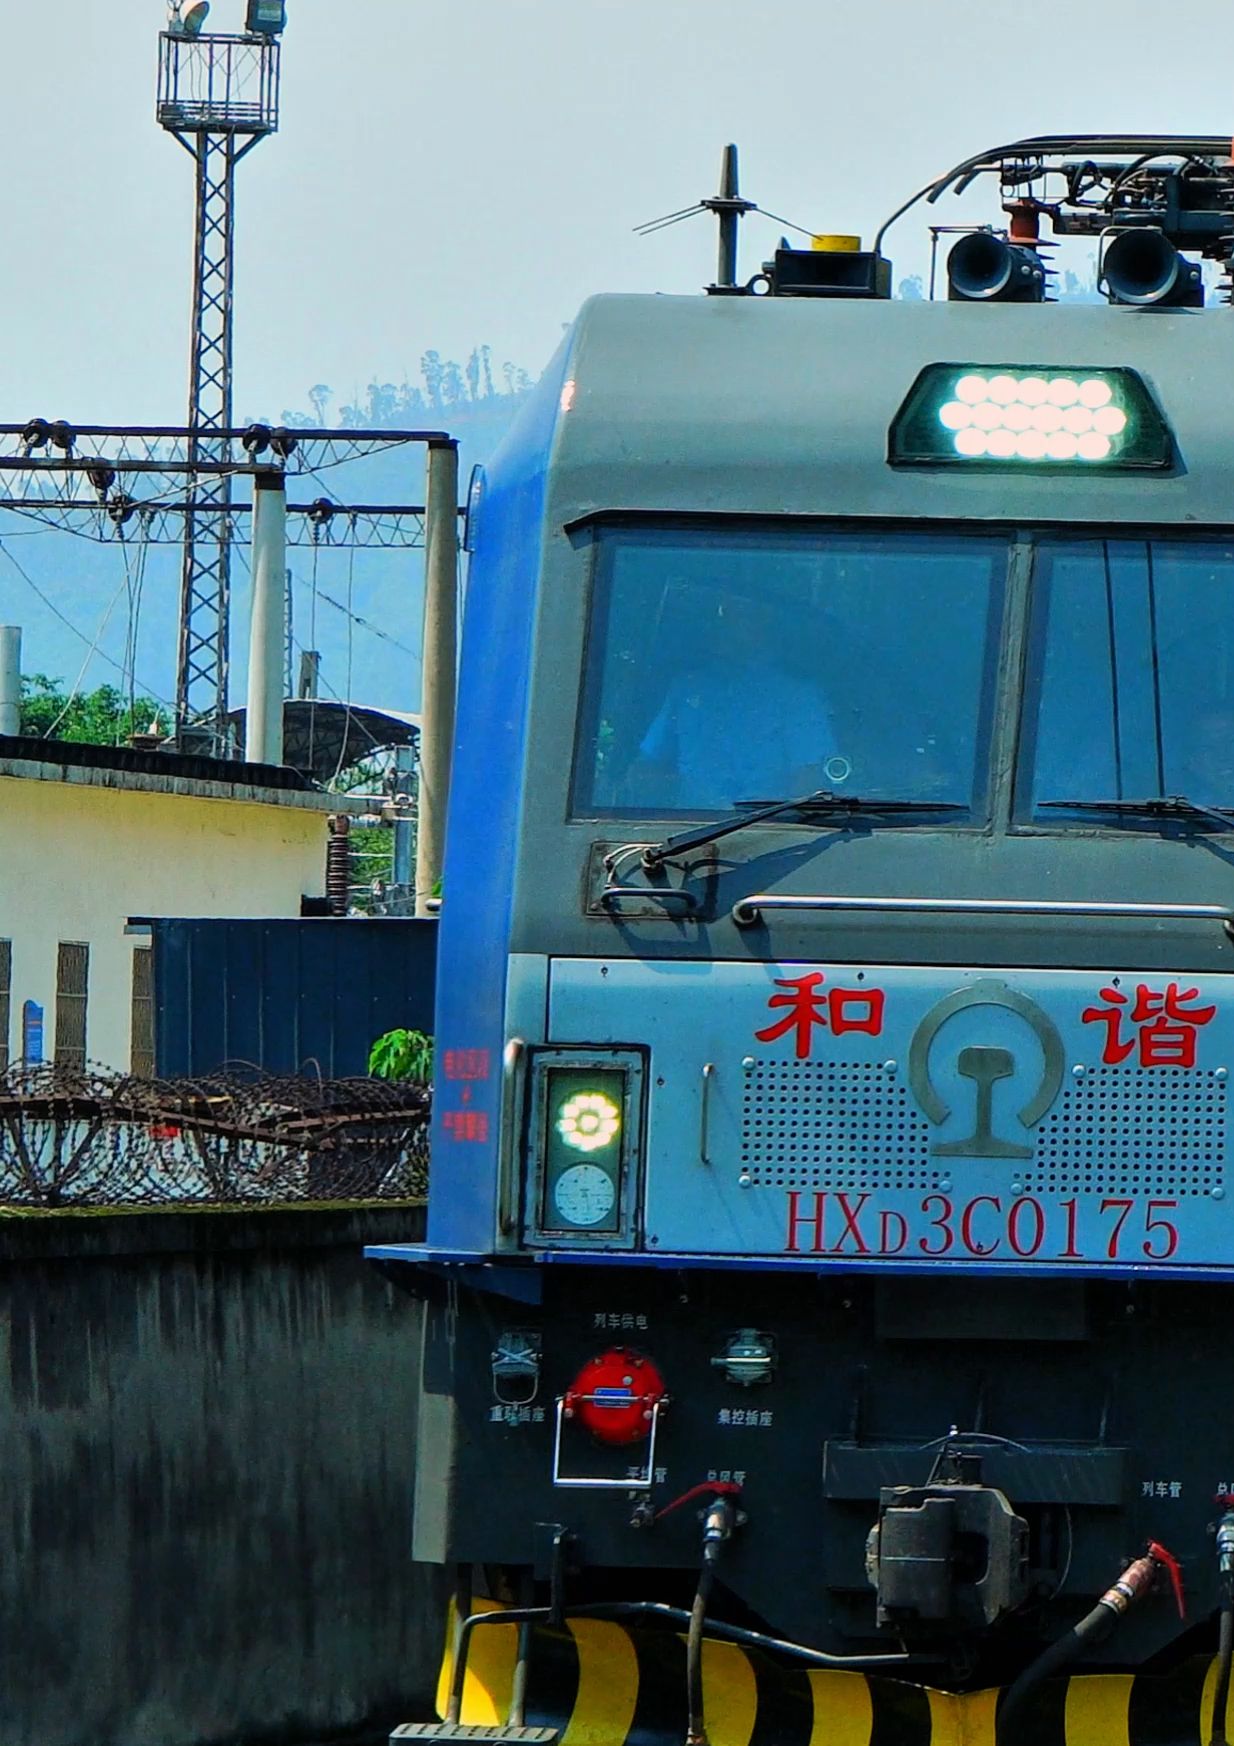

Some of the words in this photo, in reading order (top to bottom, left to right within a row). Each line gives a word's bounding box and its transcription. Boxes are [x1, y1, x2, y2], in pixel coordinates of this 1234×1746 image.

[783, 1190, 1180, 1261] HXD3C0175
[594, 1312, 649, 1330] 列车供电
[718, 1407, 773, 1427] 集控插座
[1142, 1480, 1182, 1499] 列车管
